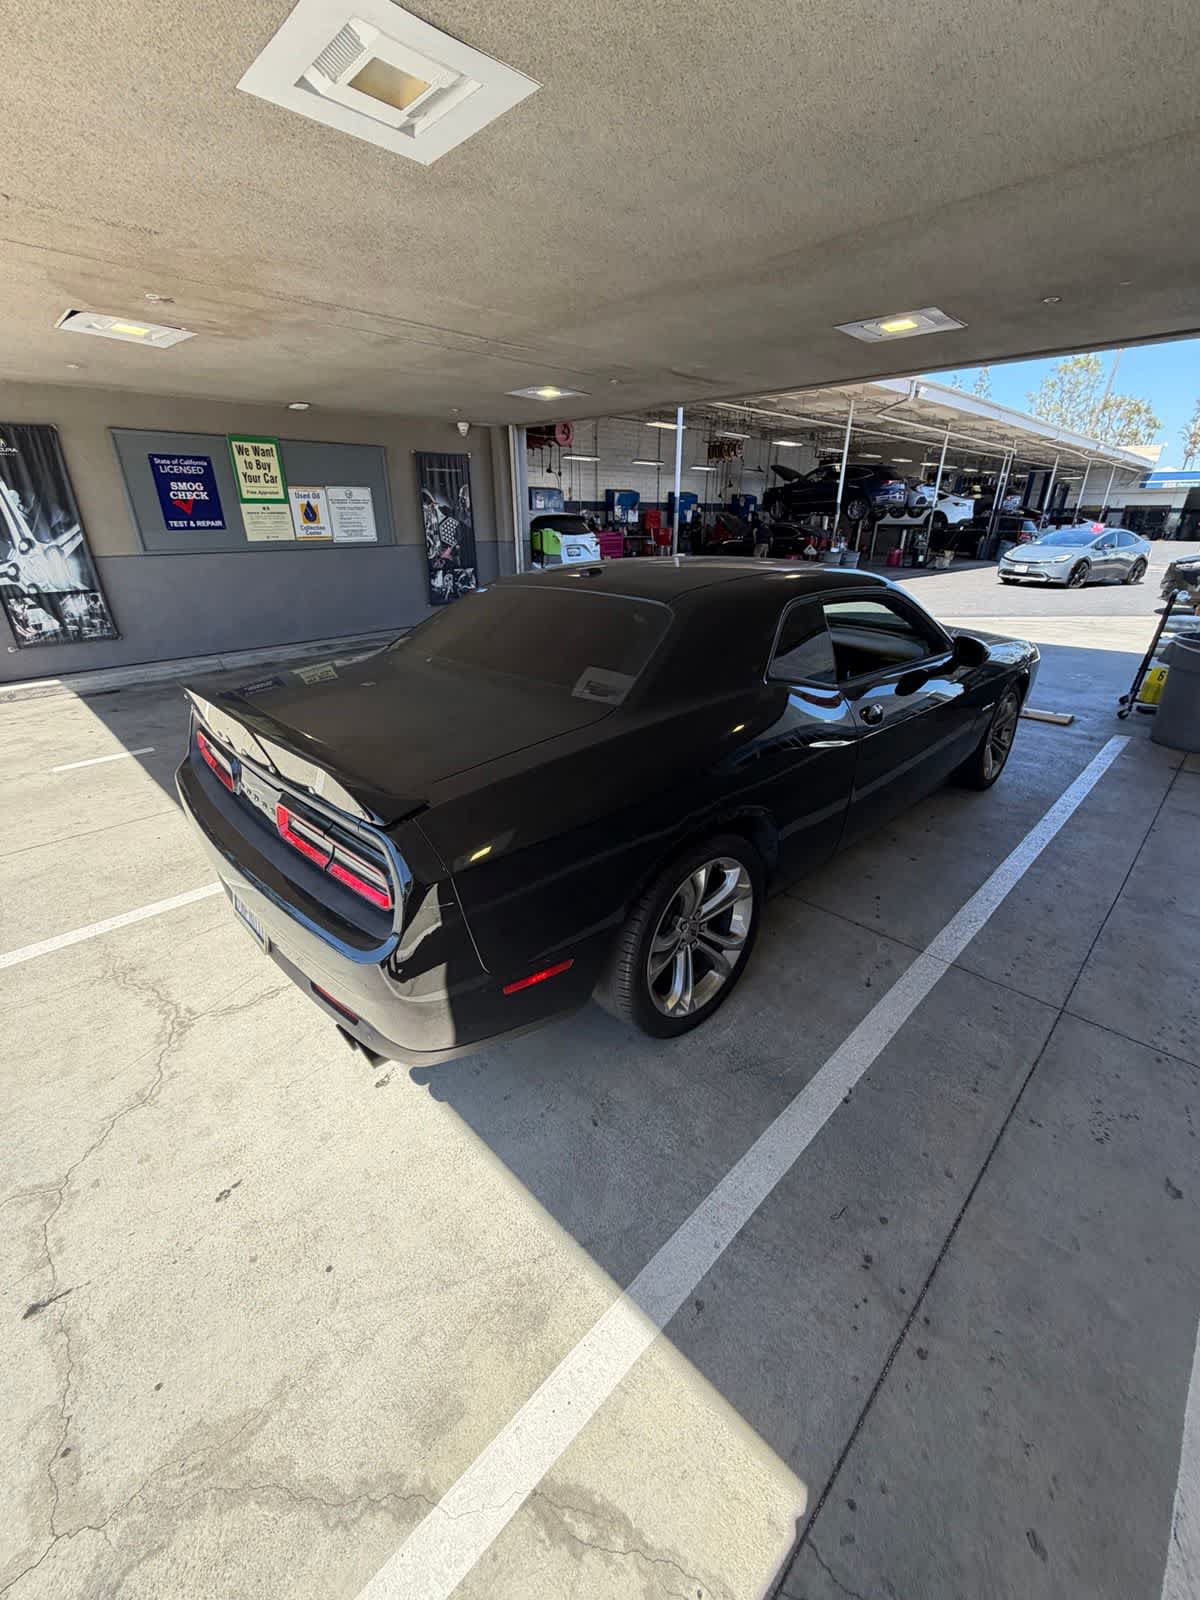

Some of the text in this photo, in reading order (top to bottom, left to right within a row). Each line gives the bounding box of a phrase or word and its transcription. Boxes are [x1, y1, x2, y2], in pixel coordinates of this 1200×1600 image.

[235, 444, 275, 458] We Want
[154, 457, 170, 465] State
[179, 458, 207, 466] California
[244, 459, 271, 473] to Buy
[159, 465, 204, 475] LICENSED
[241, 471, 278, 484] Your Car
[170, 481, 204, 491] SMOG
[169, 491, 209, 500] CHECK
